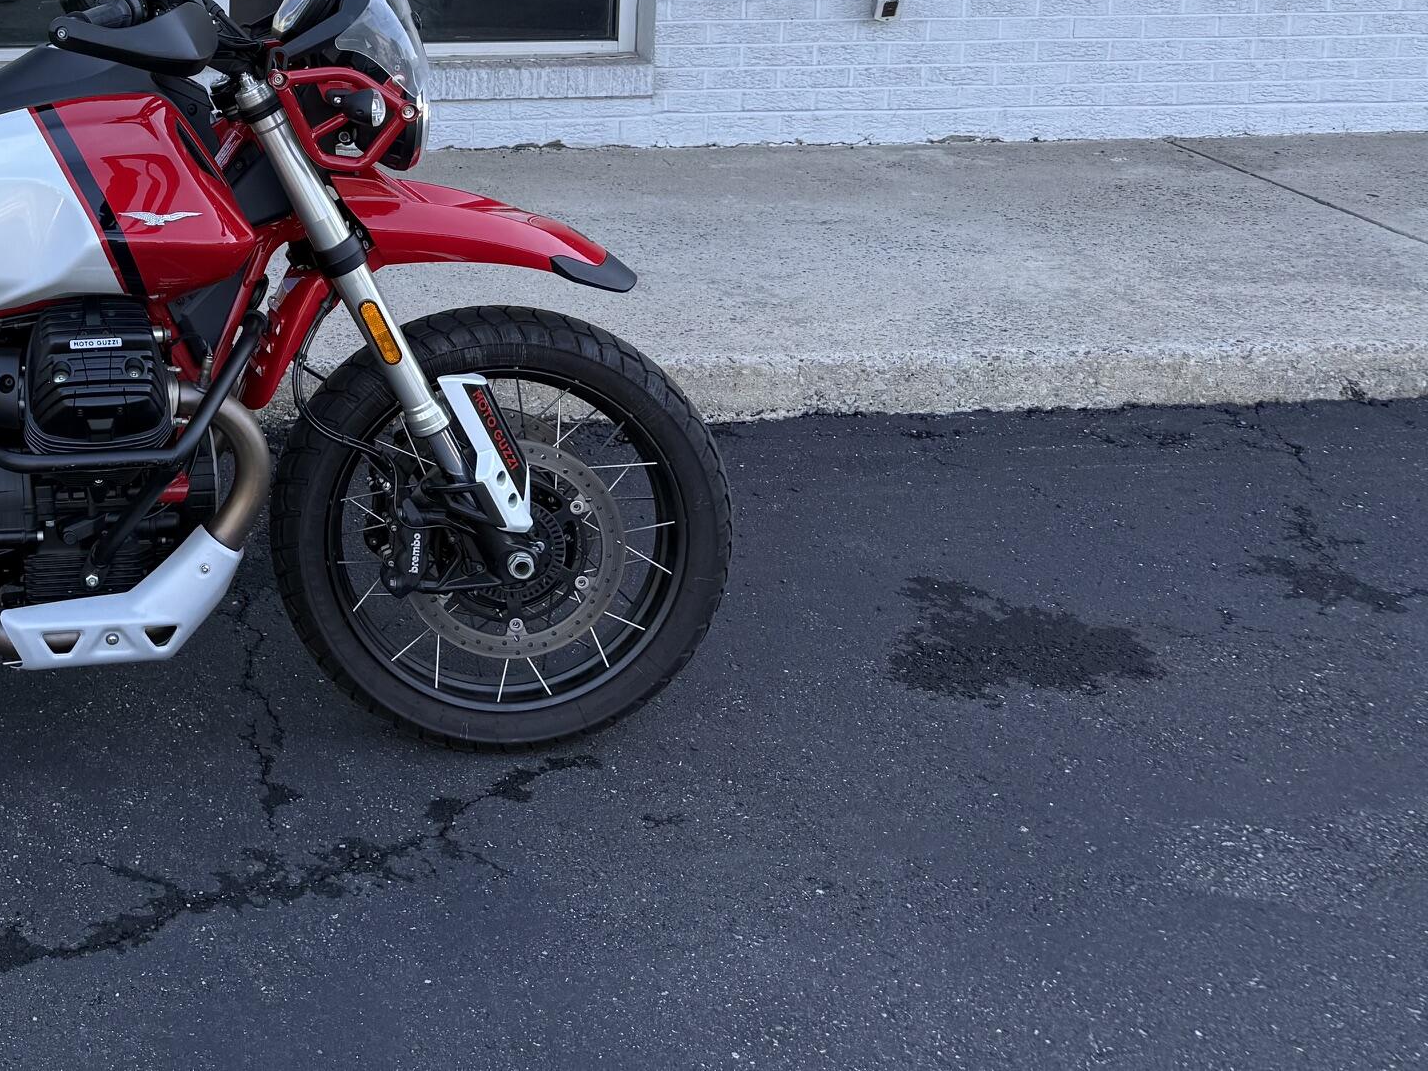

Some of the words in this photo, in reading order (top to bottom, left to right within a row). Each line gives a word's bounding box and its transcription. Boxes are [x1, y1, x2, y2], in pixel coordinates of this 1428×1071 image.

[472, 389, 496, 429] MOTO
[494, 430, 519, 471] GUZZI
[409, 533, 421, 574] brembo
